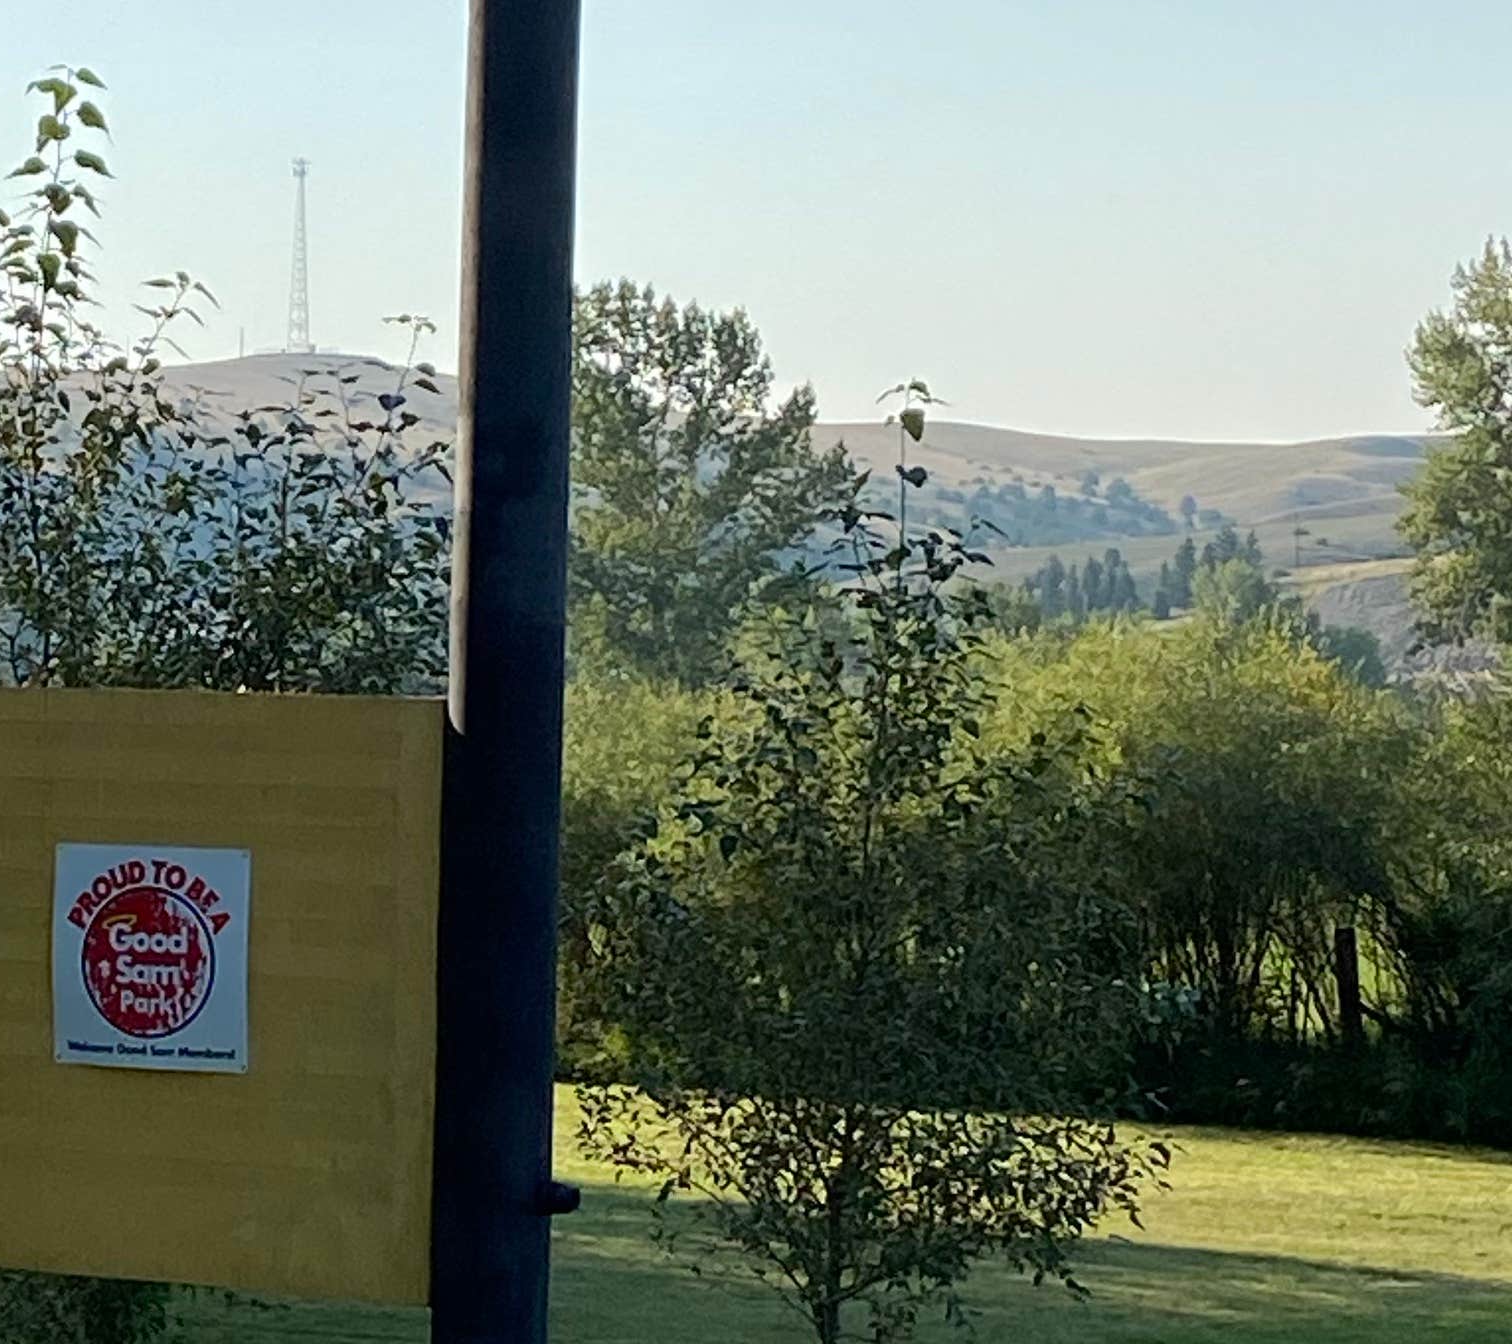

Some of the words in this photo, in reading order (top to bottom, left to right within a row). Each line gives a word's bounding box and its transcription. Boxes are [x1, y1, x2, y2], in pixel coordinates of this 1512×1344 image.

[66, 860, 146, 930] PROUD
[150, 859, 187, 890] TO
[185, 876, 220, 912] BE
[209, 911, 231, 936] A
[109, 921, 188, 955] Good
[115, 954, 180, 986] Sam
[120, 989, 174, 1014] Park
